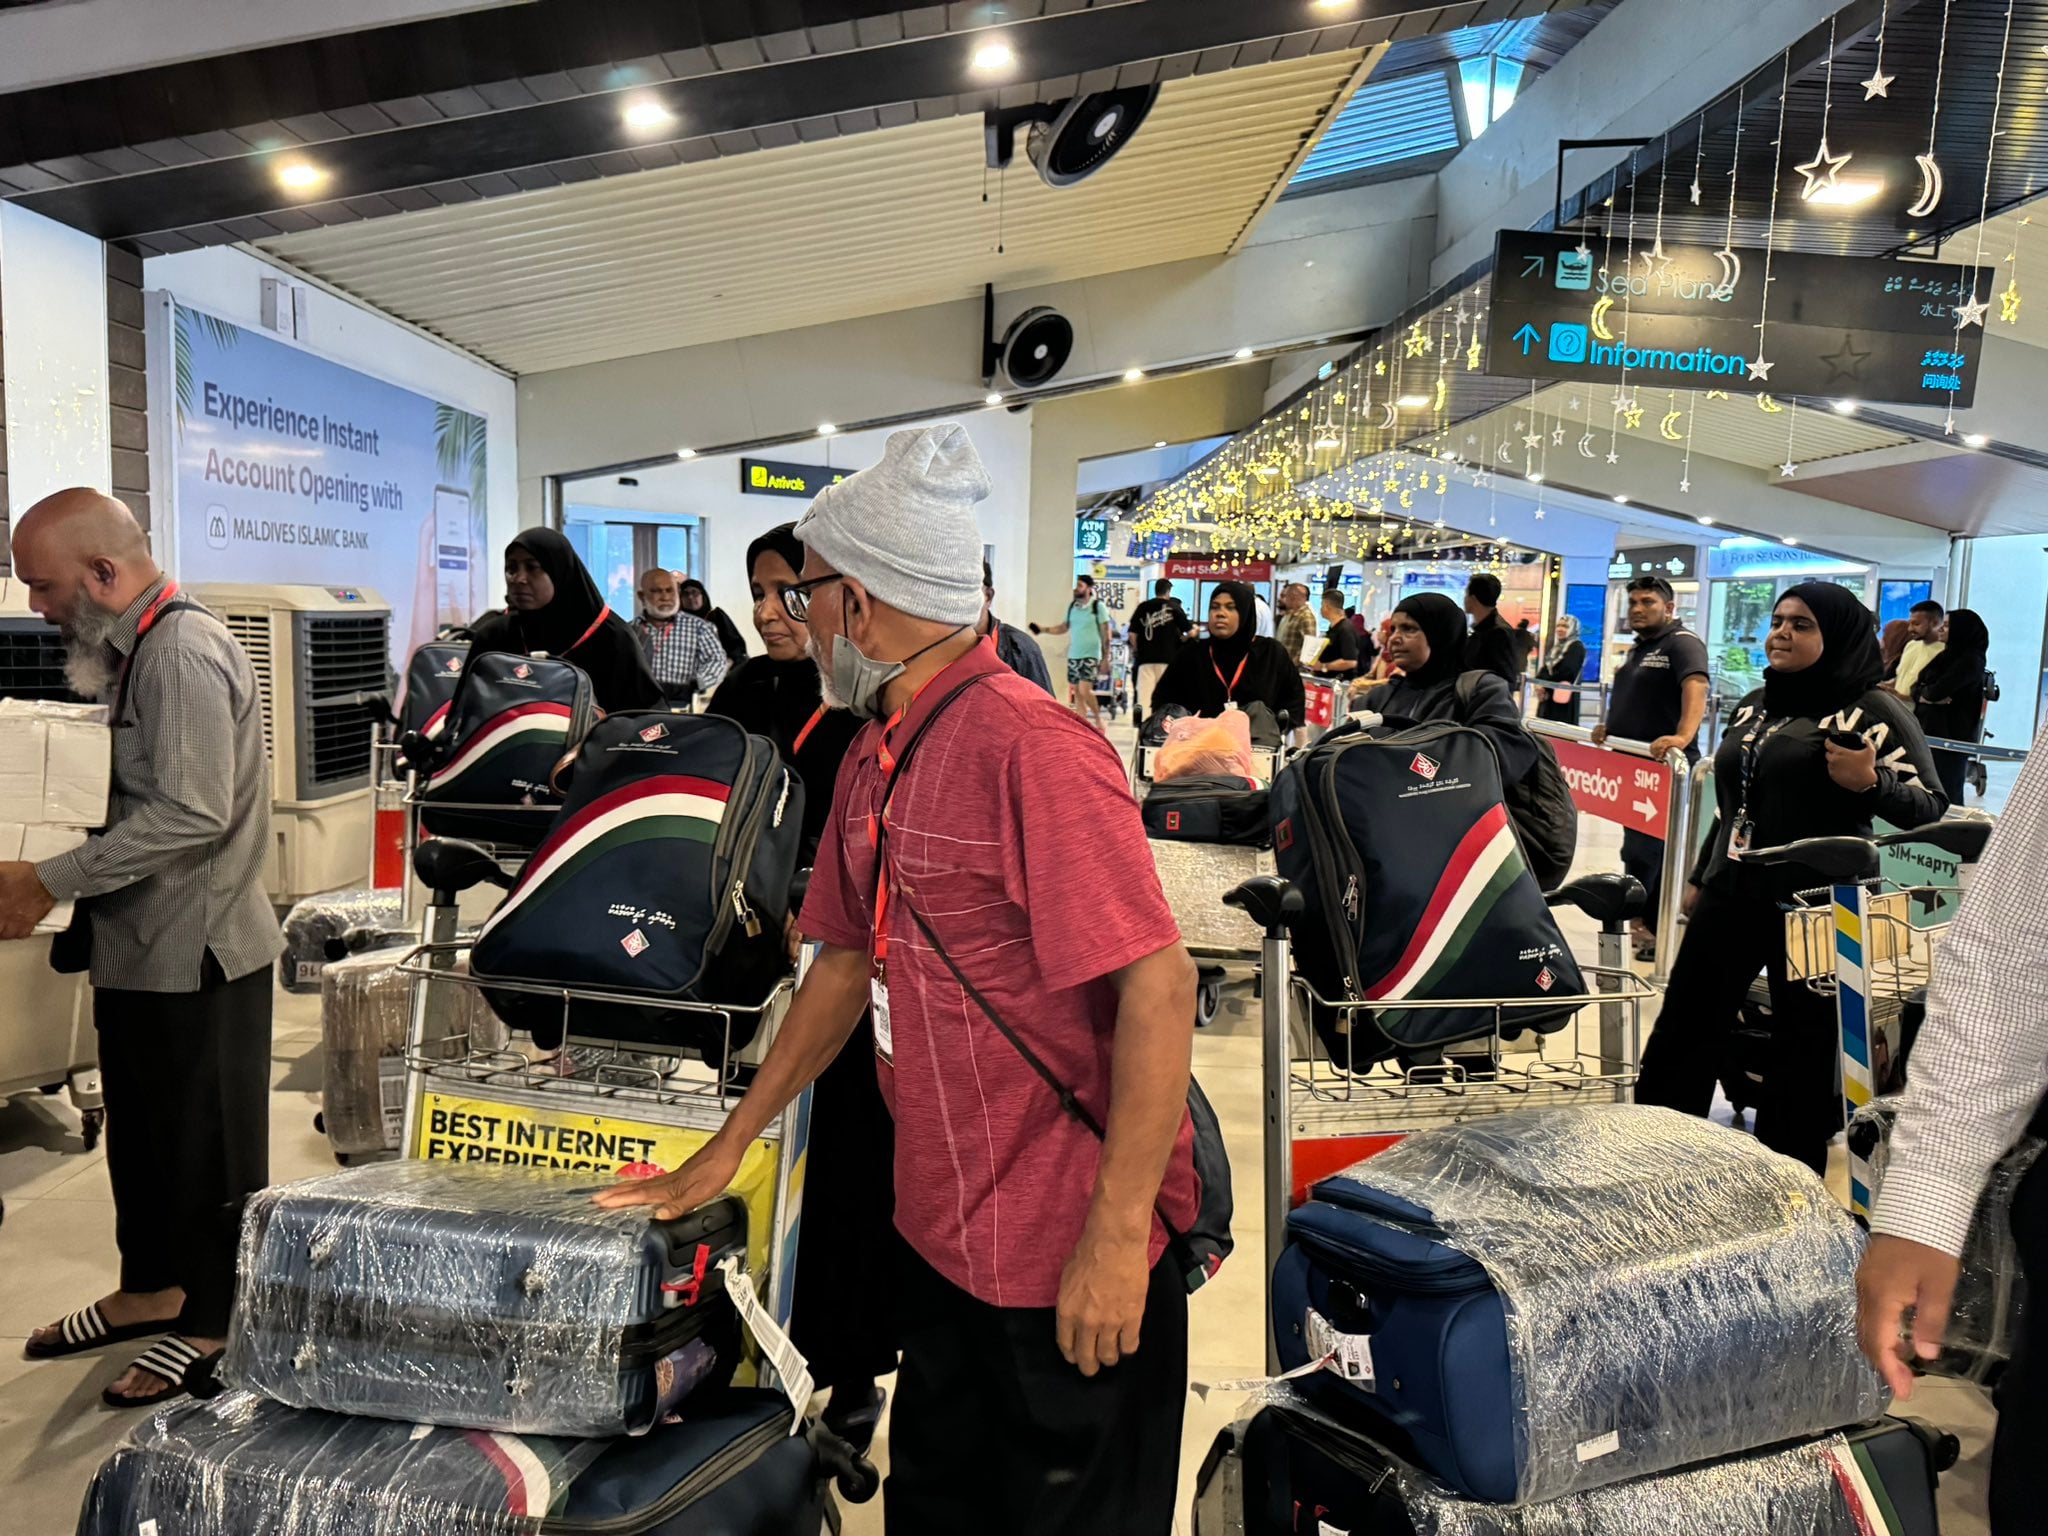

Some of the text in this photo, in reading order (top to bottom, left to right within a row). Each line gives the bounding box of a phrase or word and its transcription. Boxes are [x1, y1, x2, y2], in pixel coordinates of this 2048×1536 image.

[1596, 271, 1734, 302] Sea Plane
[1590, 340, 1745, 375] Information
[1921, 373, 1961, 391] 问询处
[204, 381, 380, 457] Experience Instant
[204, 448, 403, 512] Account Opening with
[768, 475, 806, 491] Arrivals
[233, 517, 369, 550] MALDIVES ISLAMIC BANK
[1081, 521, 1105, 531] ATM
[1756, 550, 1798, 562] SEASONS
[1633, 768, 1660, 792] SIM?
[1888, 844, 1958, 878] SIM-карту
[430, 1109, 501, 1142] BEST
[507, 1120, 657, 1164] INTERNET
